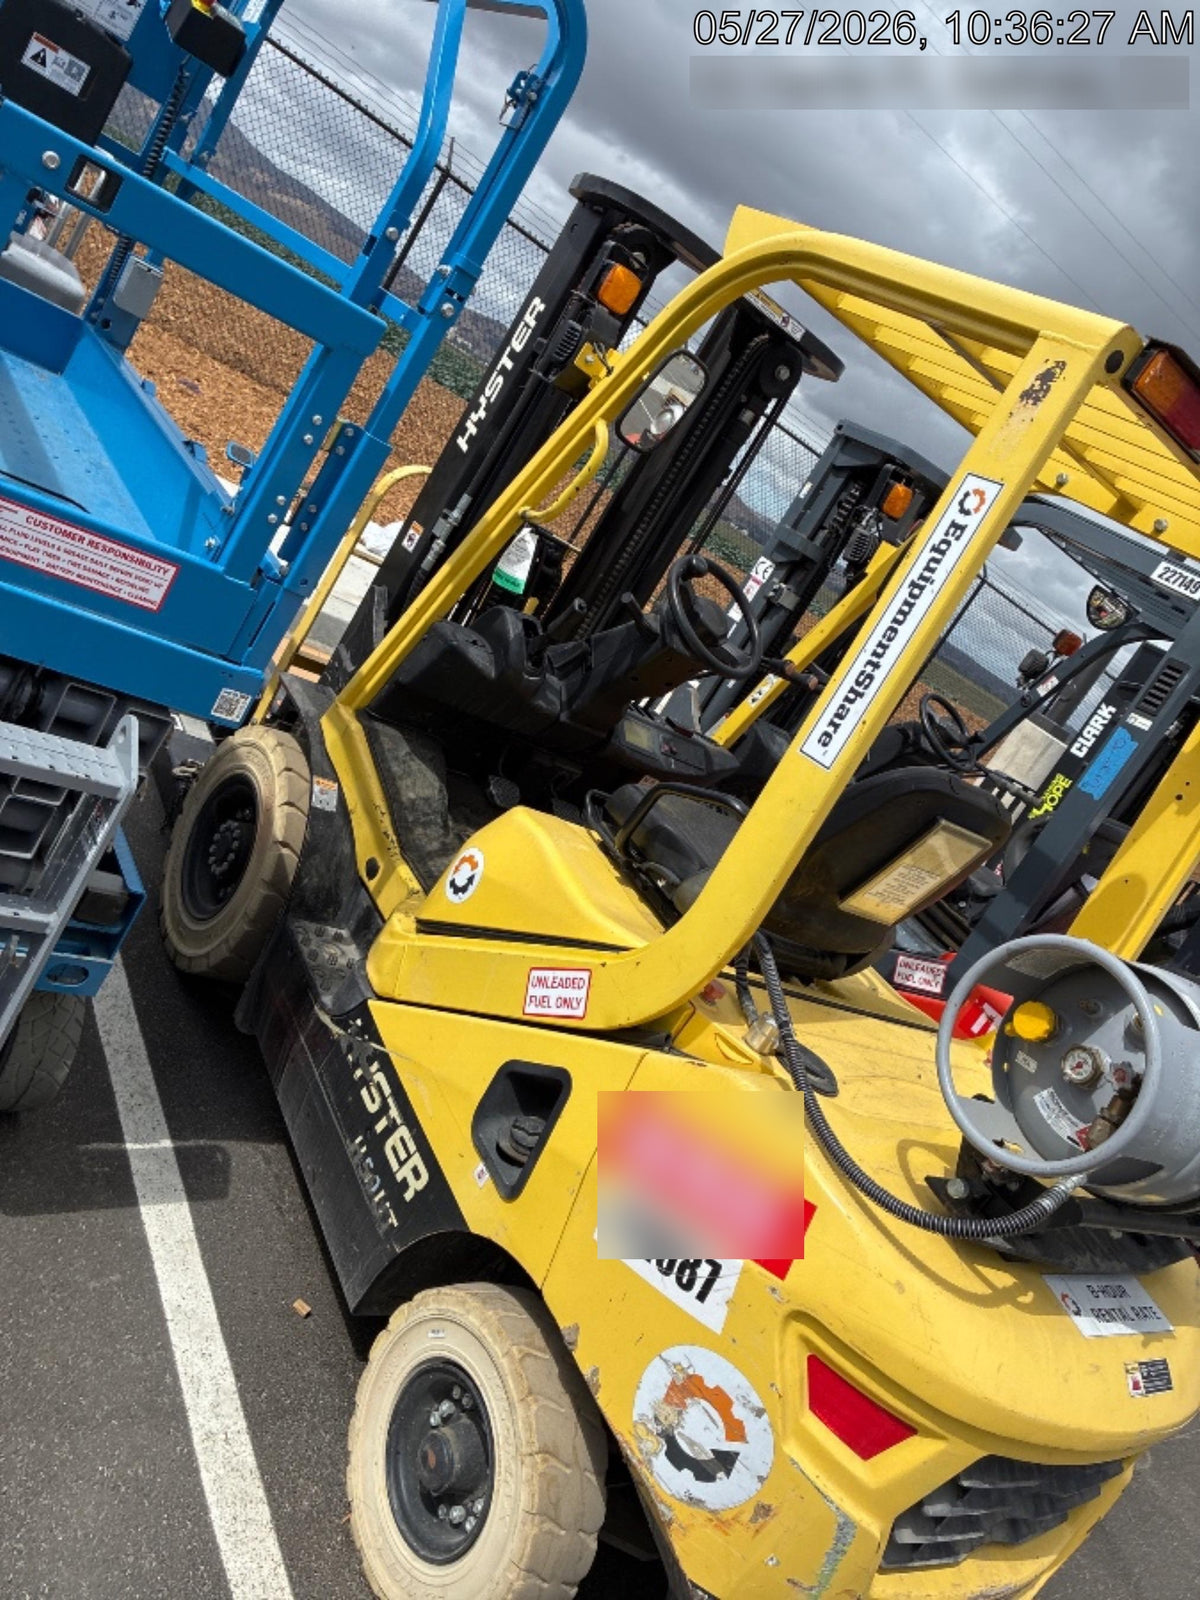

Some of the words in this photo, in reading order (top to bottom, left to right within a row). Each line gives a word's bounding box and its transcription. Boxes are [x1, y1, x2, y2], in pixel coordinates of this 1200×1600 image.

[456, 297, 546, 453] HYSTER
[26, 515, 86, 544] CUSTOMER
[87, 540, 170, 576] RESPONSIBILITY
[817, 521, 969, 749] EquipmentShare
[1070, 703, 1117, 758] CLARK
[528, 994, 552, 1009] FUEL
[555, 995, 584, 1011] ONLY
[531, 975, 586, 990] UNLEADED
[349, 1018, 429, 1202] STER
[1090, 1307, 1135, 1323] RENTAL
[1130, 1306, 1162, 1321] RATE
